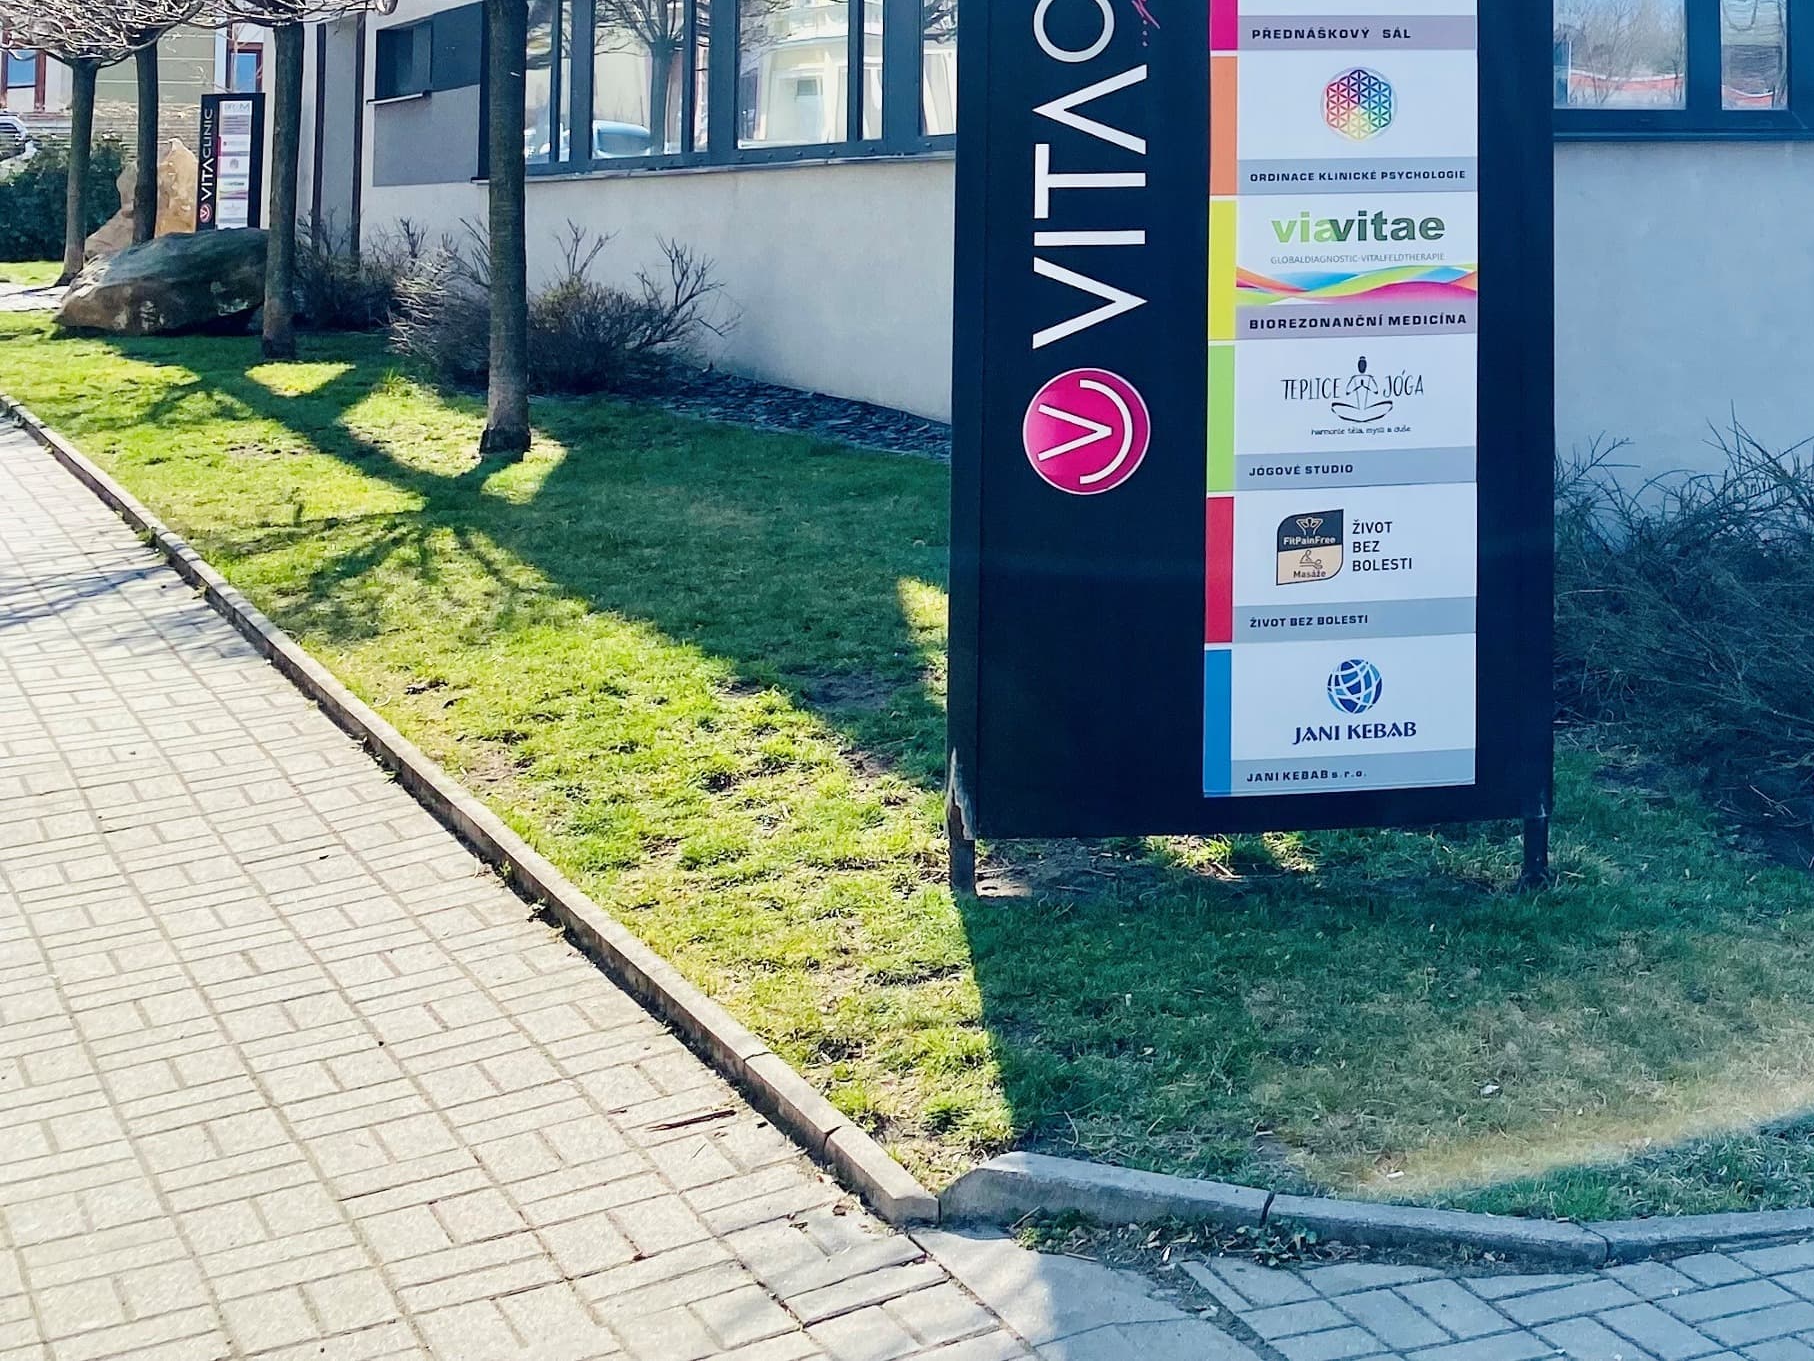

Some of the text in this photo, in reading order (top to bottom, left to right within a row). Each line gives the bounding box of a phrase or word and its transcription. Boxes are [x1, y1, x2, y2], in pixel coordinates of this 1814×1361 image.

[1251, 25, 1412, 40] PŘEDNÁŠKOVÝ SÁL
[201, 108, 214, 201] VITACLINIC
[1249, 169, 1466, 183] ORDINACE KLINICKÉ PSYCHOLOGIE
[1271, 210, 1446, 244] viavitae
[1249, 311, 1467, 330] BIOREZONANČNÍ MEDICÍNA
[1280, 369, 1424, 401] TEPLICE JÓGA
[1304, 464, 1354, 475] STUDIO
[1352, 519, 1393, 535] ŽIVOT
[1283, 535, 1337, 545] FitPainFree
[1352, 540, 1380, 554] BEZ
[1352, 557, 1413, 572] BOLESTI
[1293, 568, 1327, 579] Masáže
[1249, 614, 1368, 628] ŽIVOT BEZ BOLESTI
[1292, 721, 1417, 745] JANI KEBAB
[1246, 771, 1279, 783] JANI
[1282, 769, 1329, 781] KEBAB
